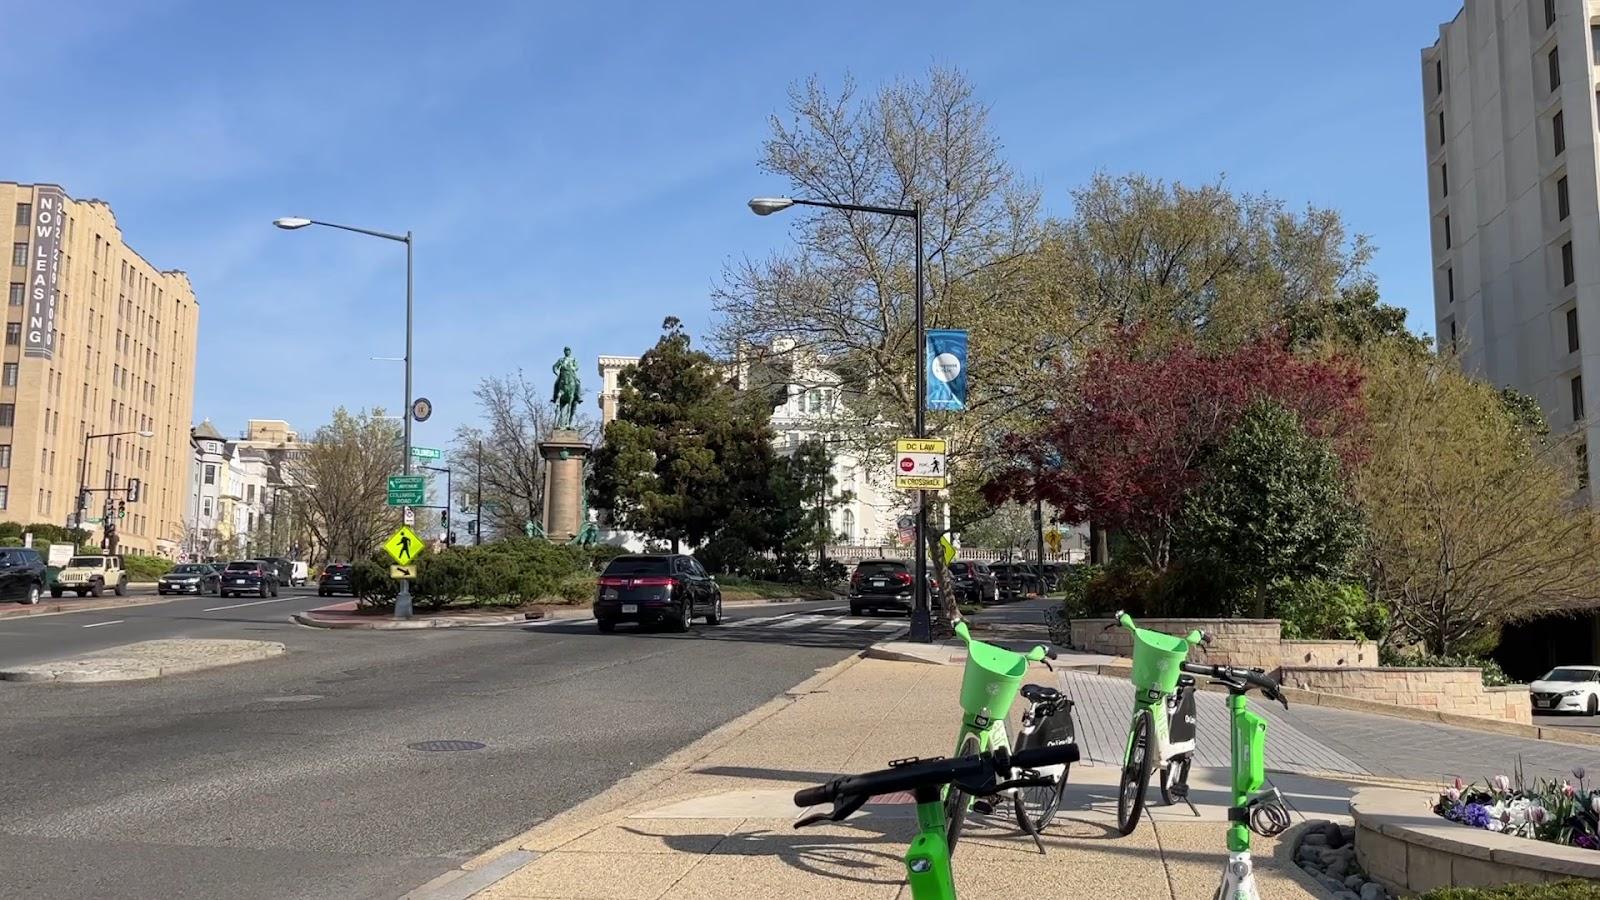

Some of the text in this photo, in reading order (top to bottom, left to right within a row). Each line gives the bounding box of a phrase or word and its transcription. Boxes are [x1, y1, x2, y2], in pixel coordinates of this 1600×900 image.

[29, 198, 52, 342] NOW LEASING
[919, 443, 936, 451] LAW
